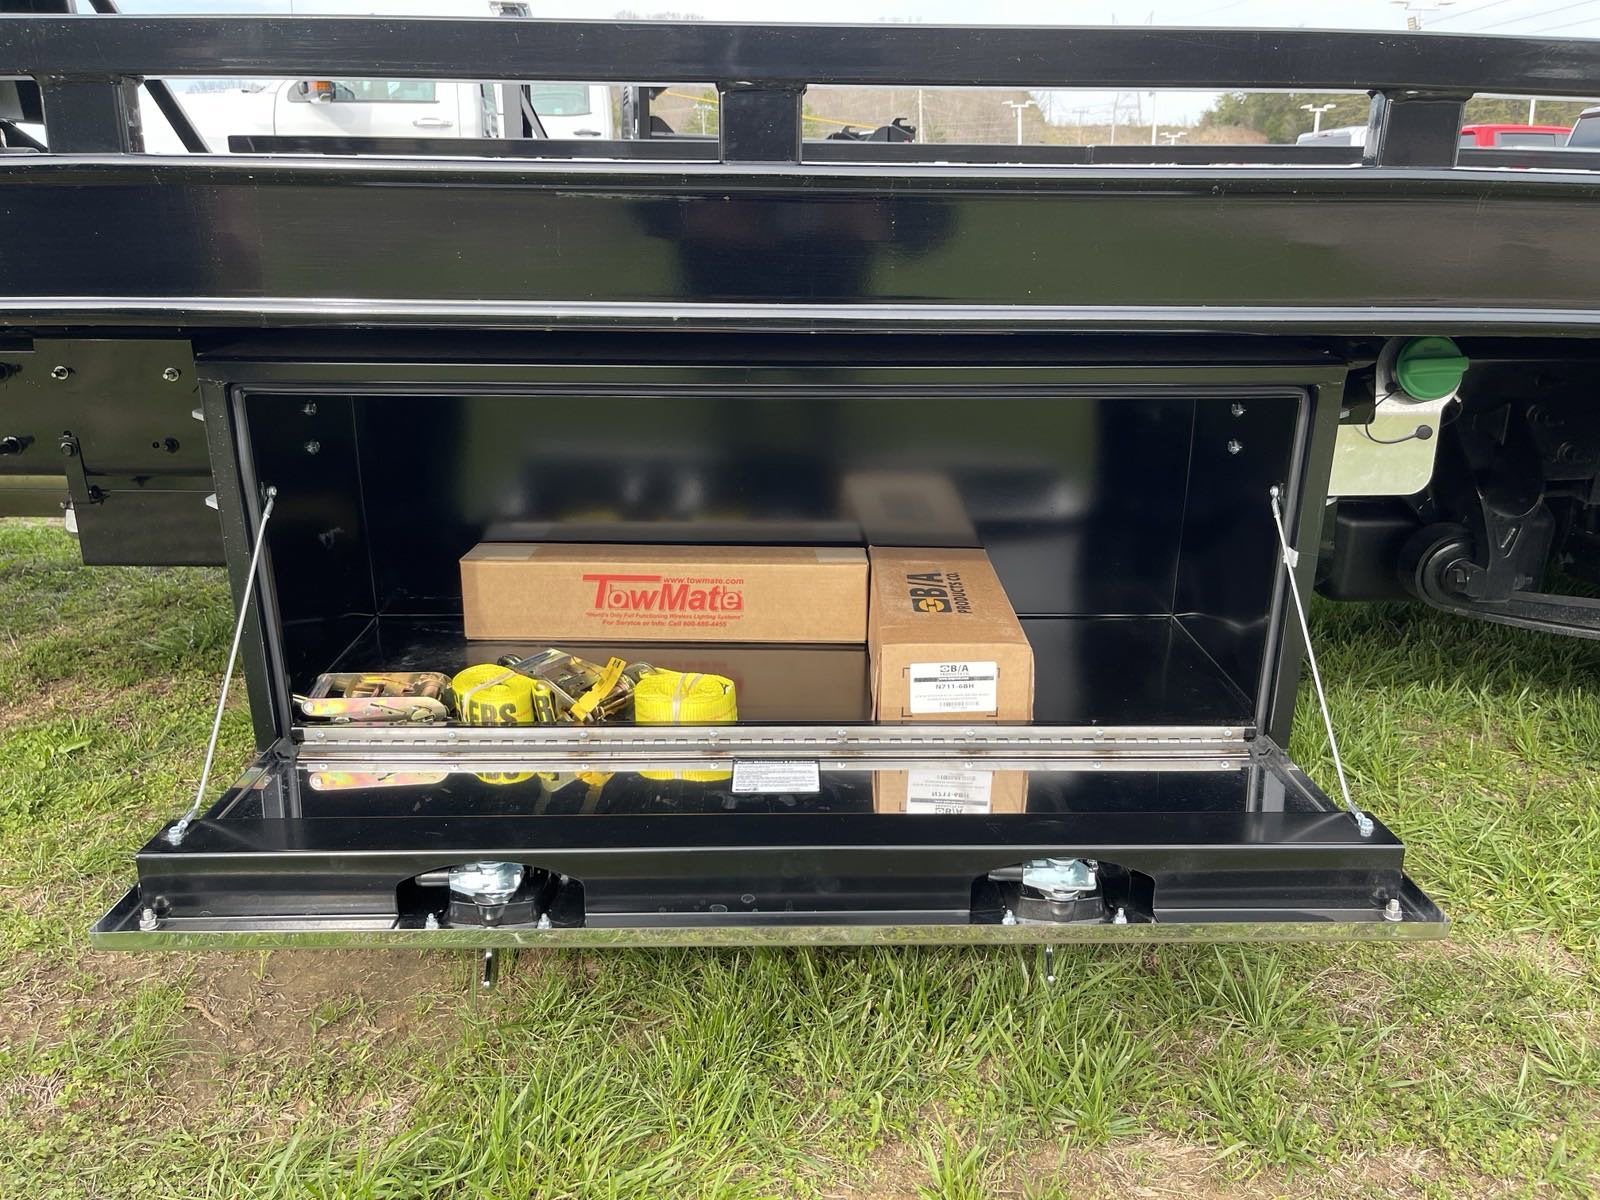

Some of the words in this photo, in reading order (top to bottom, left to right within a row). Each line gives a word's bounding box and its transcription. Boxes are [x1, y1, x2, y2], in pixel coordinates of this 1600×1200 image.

[582, 574, 743, 611] TowMate
[663, 577, 744, 585] www.towmate.com
[906, 572, 949, 598] B/A
[949, 582, 973, 614] PRODUCTS
[950, 664, 969, 673] B/A
